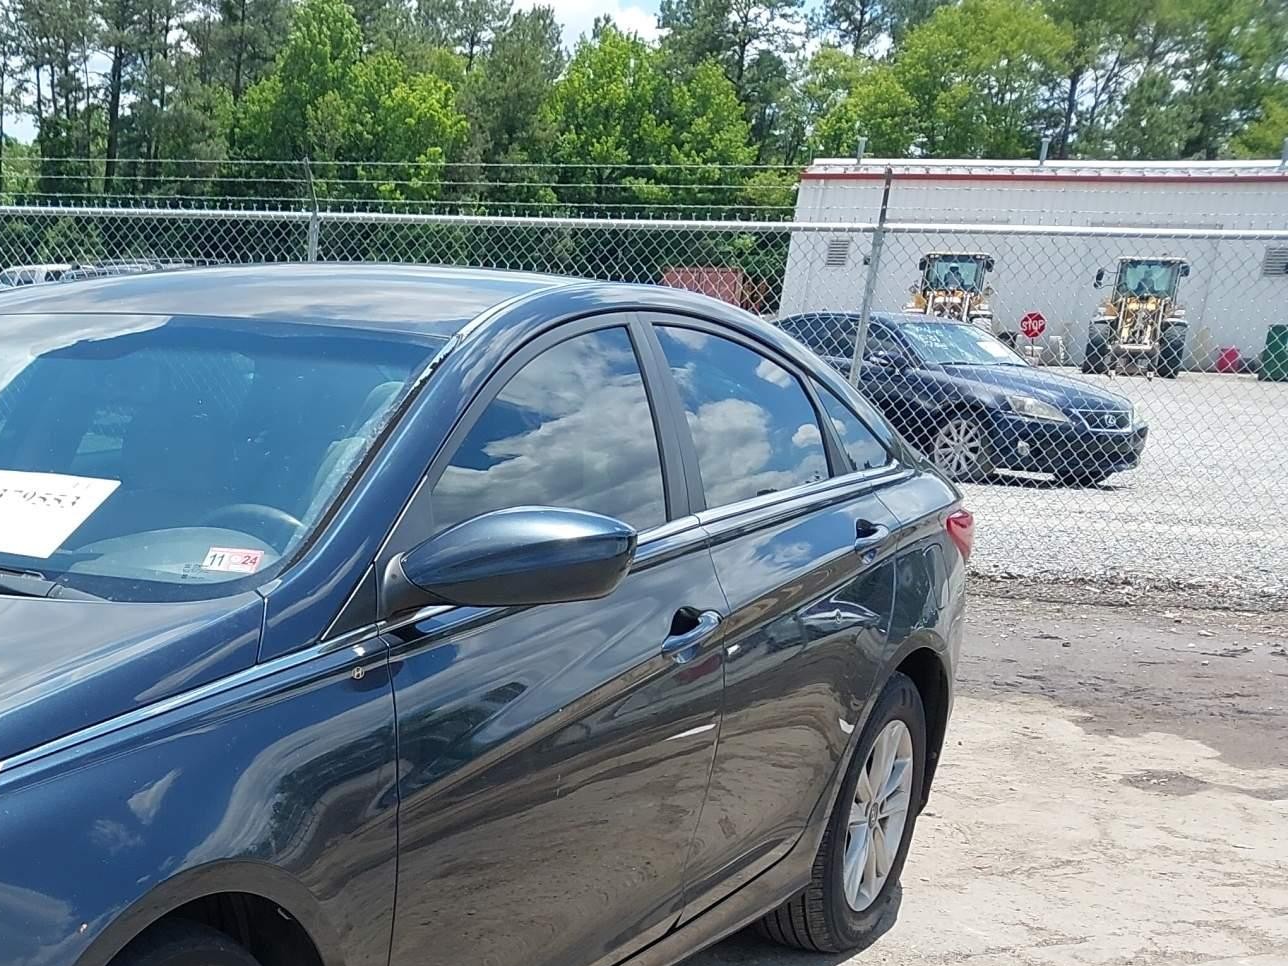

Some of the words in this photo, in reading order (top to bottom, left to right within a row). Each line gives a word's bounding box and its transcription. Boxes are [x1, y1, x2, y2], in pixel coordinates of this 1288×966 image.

[1021, 319, 1044, 331] STOP
[209, 553, 225, 567] 11
[241, 555, 258, 566] 24
